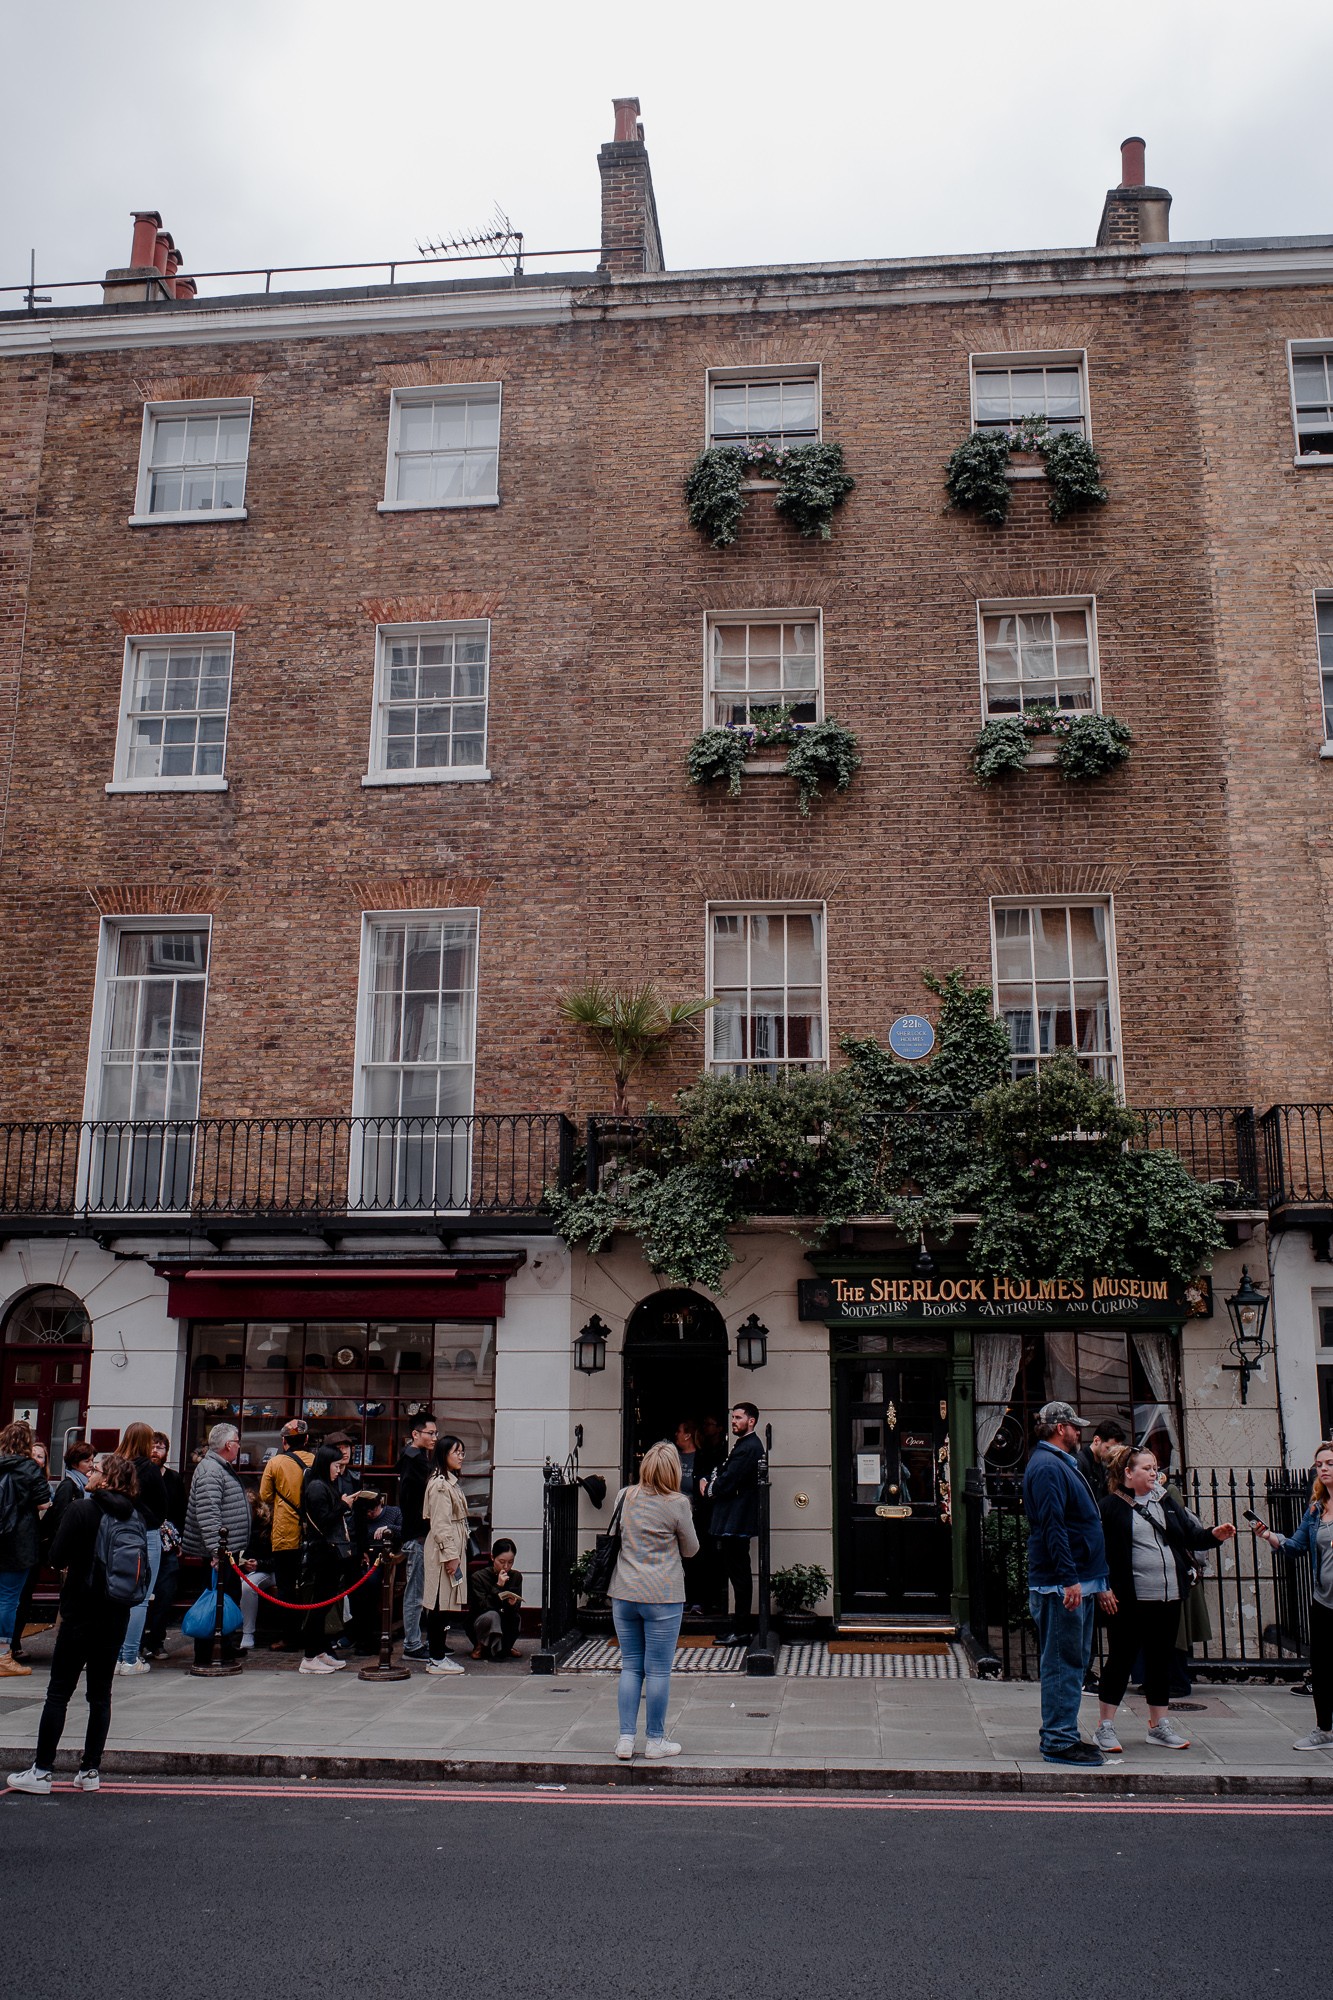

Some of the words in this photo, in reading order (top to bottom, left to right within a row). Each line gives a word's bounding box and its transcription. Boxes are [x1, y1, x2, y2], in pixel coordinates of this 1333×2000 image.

[902, 1019, 922, 1028] 221b
[870, 1278, 987, 1301] SHERLOCK
[993, 1277, 1084, 1300] HOLMES
[1066, 1302, 1089, 1312] AND
[906, 1436, 924, 1446] Open
